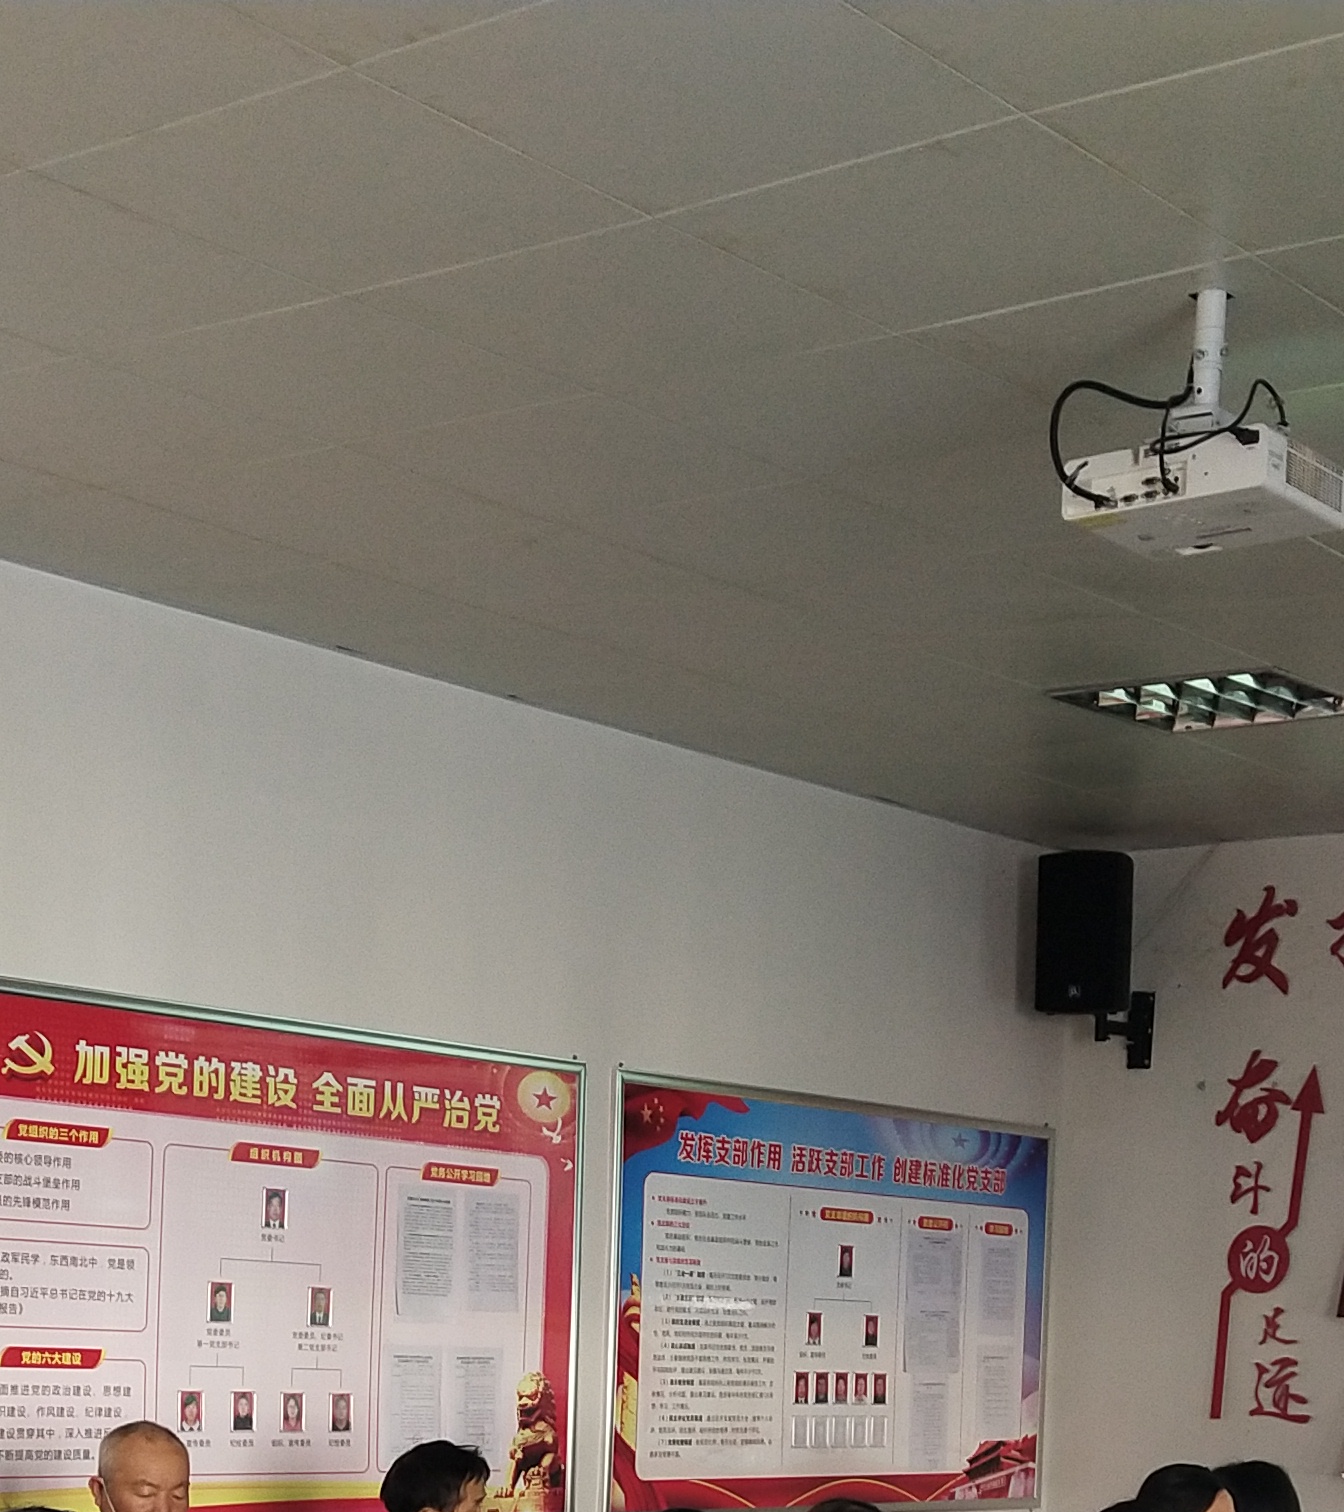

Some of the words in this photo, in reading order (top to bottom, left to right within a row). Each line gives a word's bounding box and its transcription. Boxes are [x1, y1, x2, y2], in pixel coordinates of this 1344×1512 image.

[74, 1039, 298, 1108] 加强党的建设
[311, 1070, 501, 1133] 全面从严治党
[18, 1124, 99, 1144] 党组织的三个作用
[677, 1130, 783, 1172] 发挥支部作用
[790, 1145, 886, 1182] 活跃支部工作
[892, 1157, 1008, 1196] 创建标准化党支部
[1216, 1049, 1314, 1424] 奋斗的足迹
[21, 1352, 82, 1366] 党的六大建设
